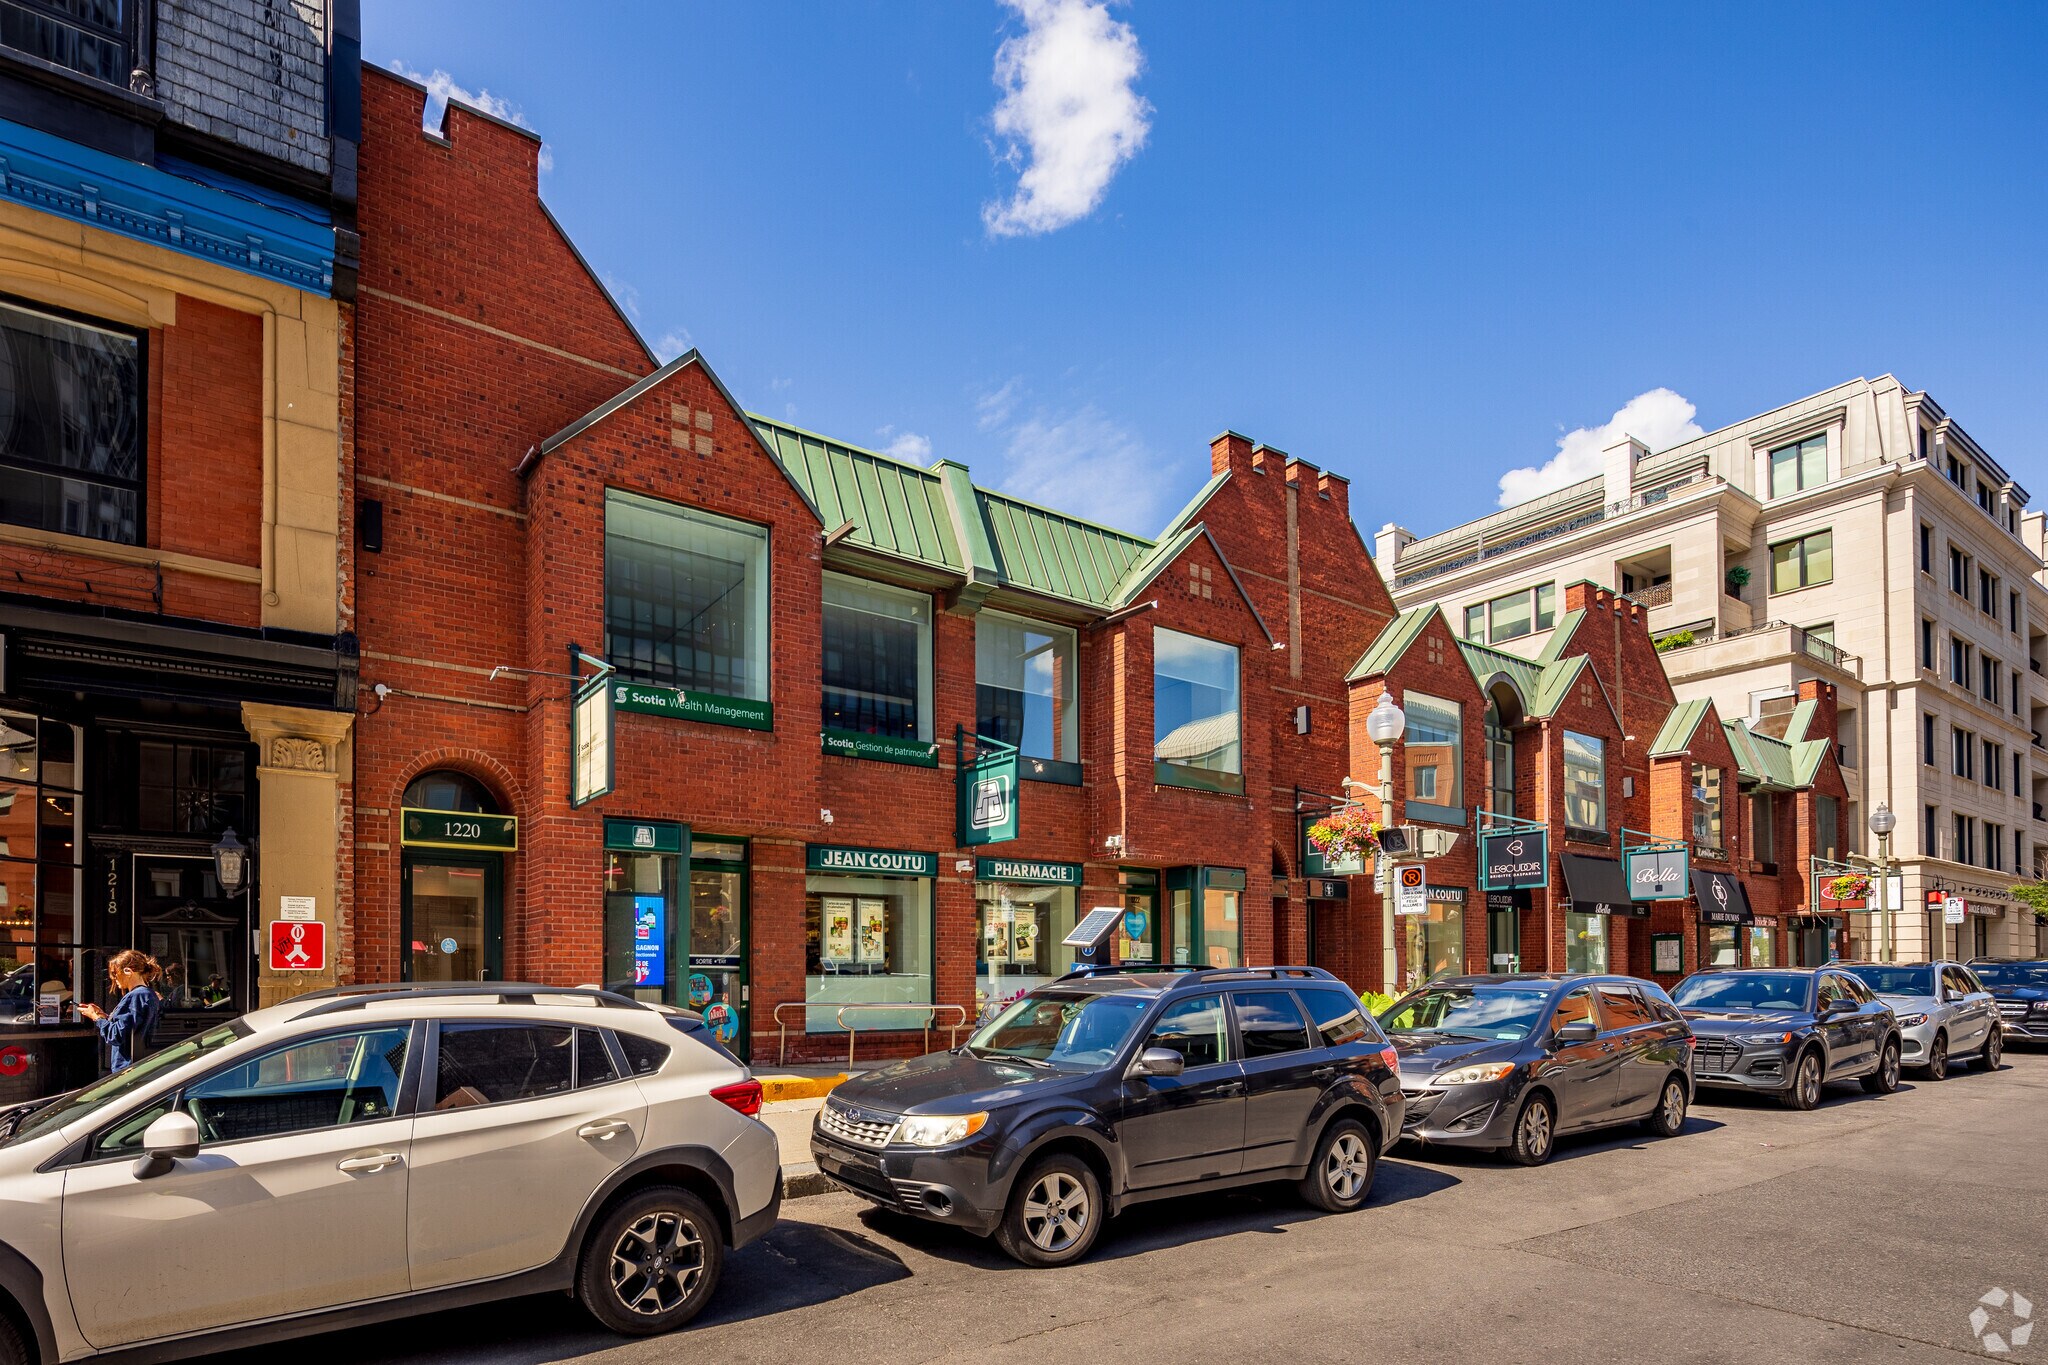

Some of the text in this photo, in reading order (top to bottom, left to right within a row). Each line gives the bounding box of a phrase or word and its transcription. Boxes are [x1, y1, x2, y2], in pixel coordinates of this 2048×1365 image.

[632, 692, 764, 721] Scotia Wealth Management
[828, 737, 931, 760] Scotia Gestion de patrimoine
[444, 822, 481, 838] 1220
[824, 850, 922, 870] JEAN COUTU
[994, 862, 1067, 880] PHARMACIE
[1635, 866, 1681, 883] Bella
[107, 858, 117, 914] 1218
[1425, 889, 1435, 899] AN
[1436, 890, 1461, 900] COUTU
[1711, 912, 1740, 922] MARIE DUMAS
[710, 1009, 727, 1021] ARRÊT
